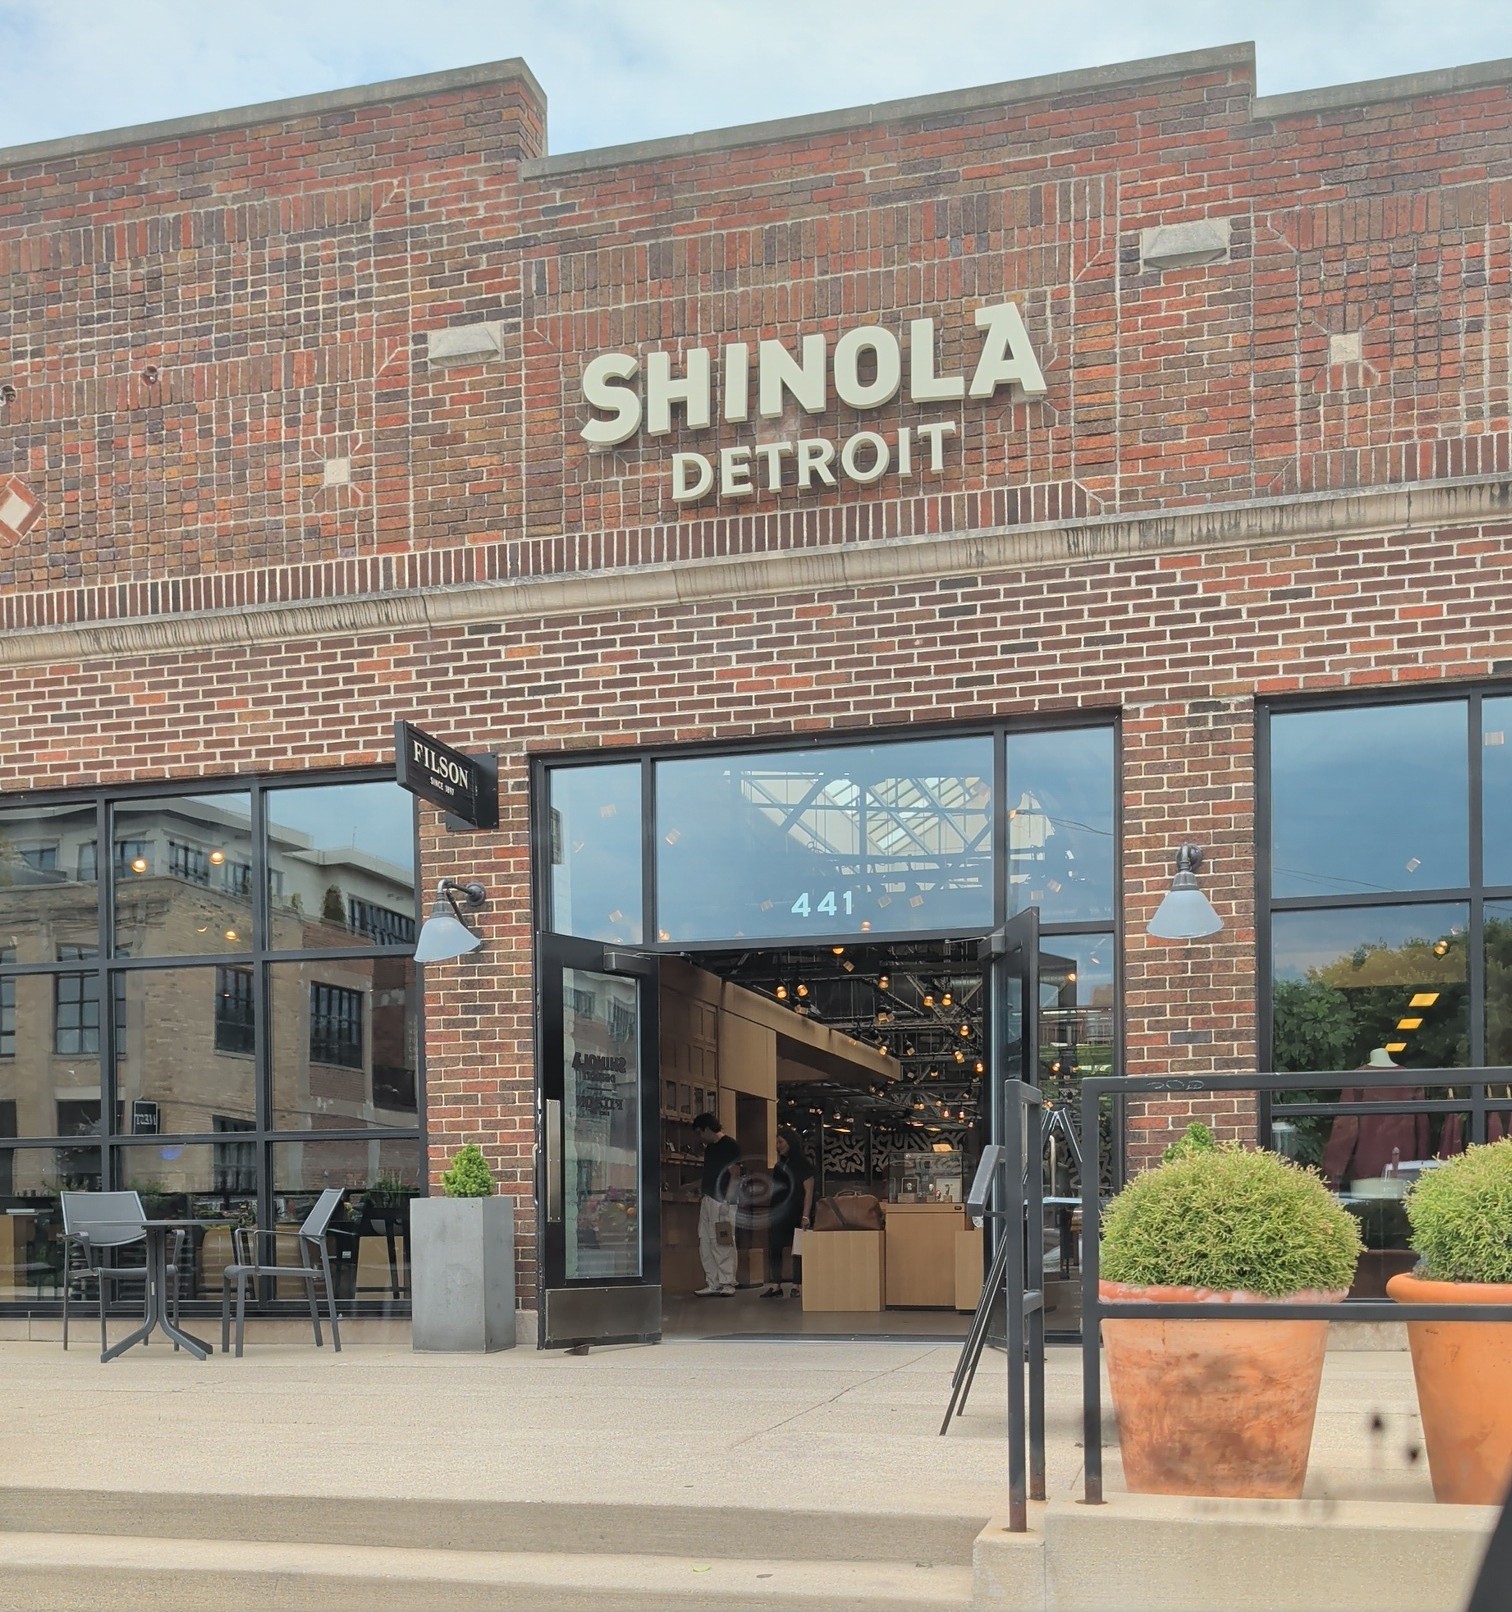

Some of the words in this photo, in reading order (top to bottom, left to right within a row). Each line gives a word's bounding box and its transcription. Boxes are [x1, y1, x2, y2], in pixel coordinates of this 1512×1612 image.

[579, 301, 1047, 446] SHINOLA
[671, 421, 956, 503] DETROIT
[412, 740, 469, 790] FILSON
[791, 890, 852, 917] 441
